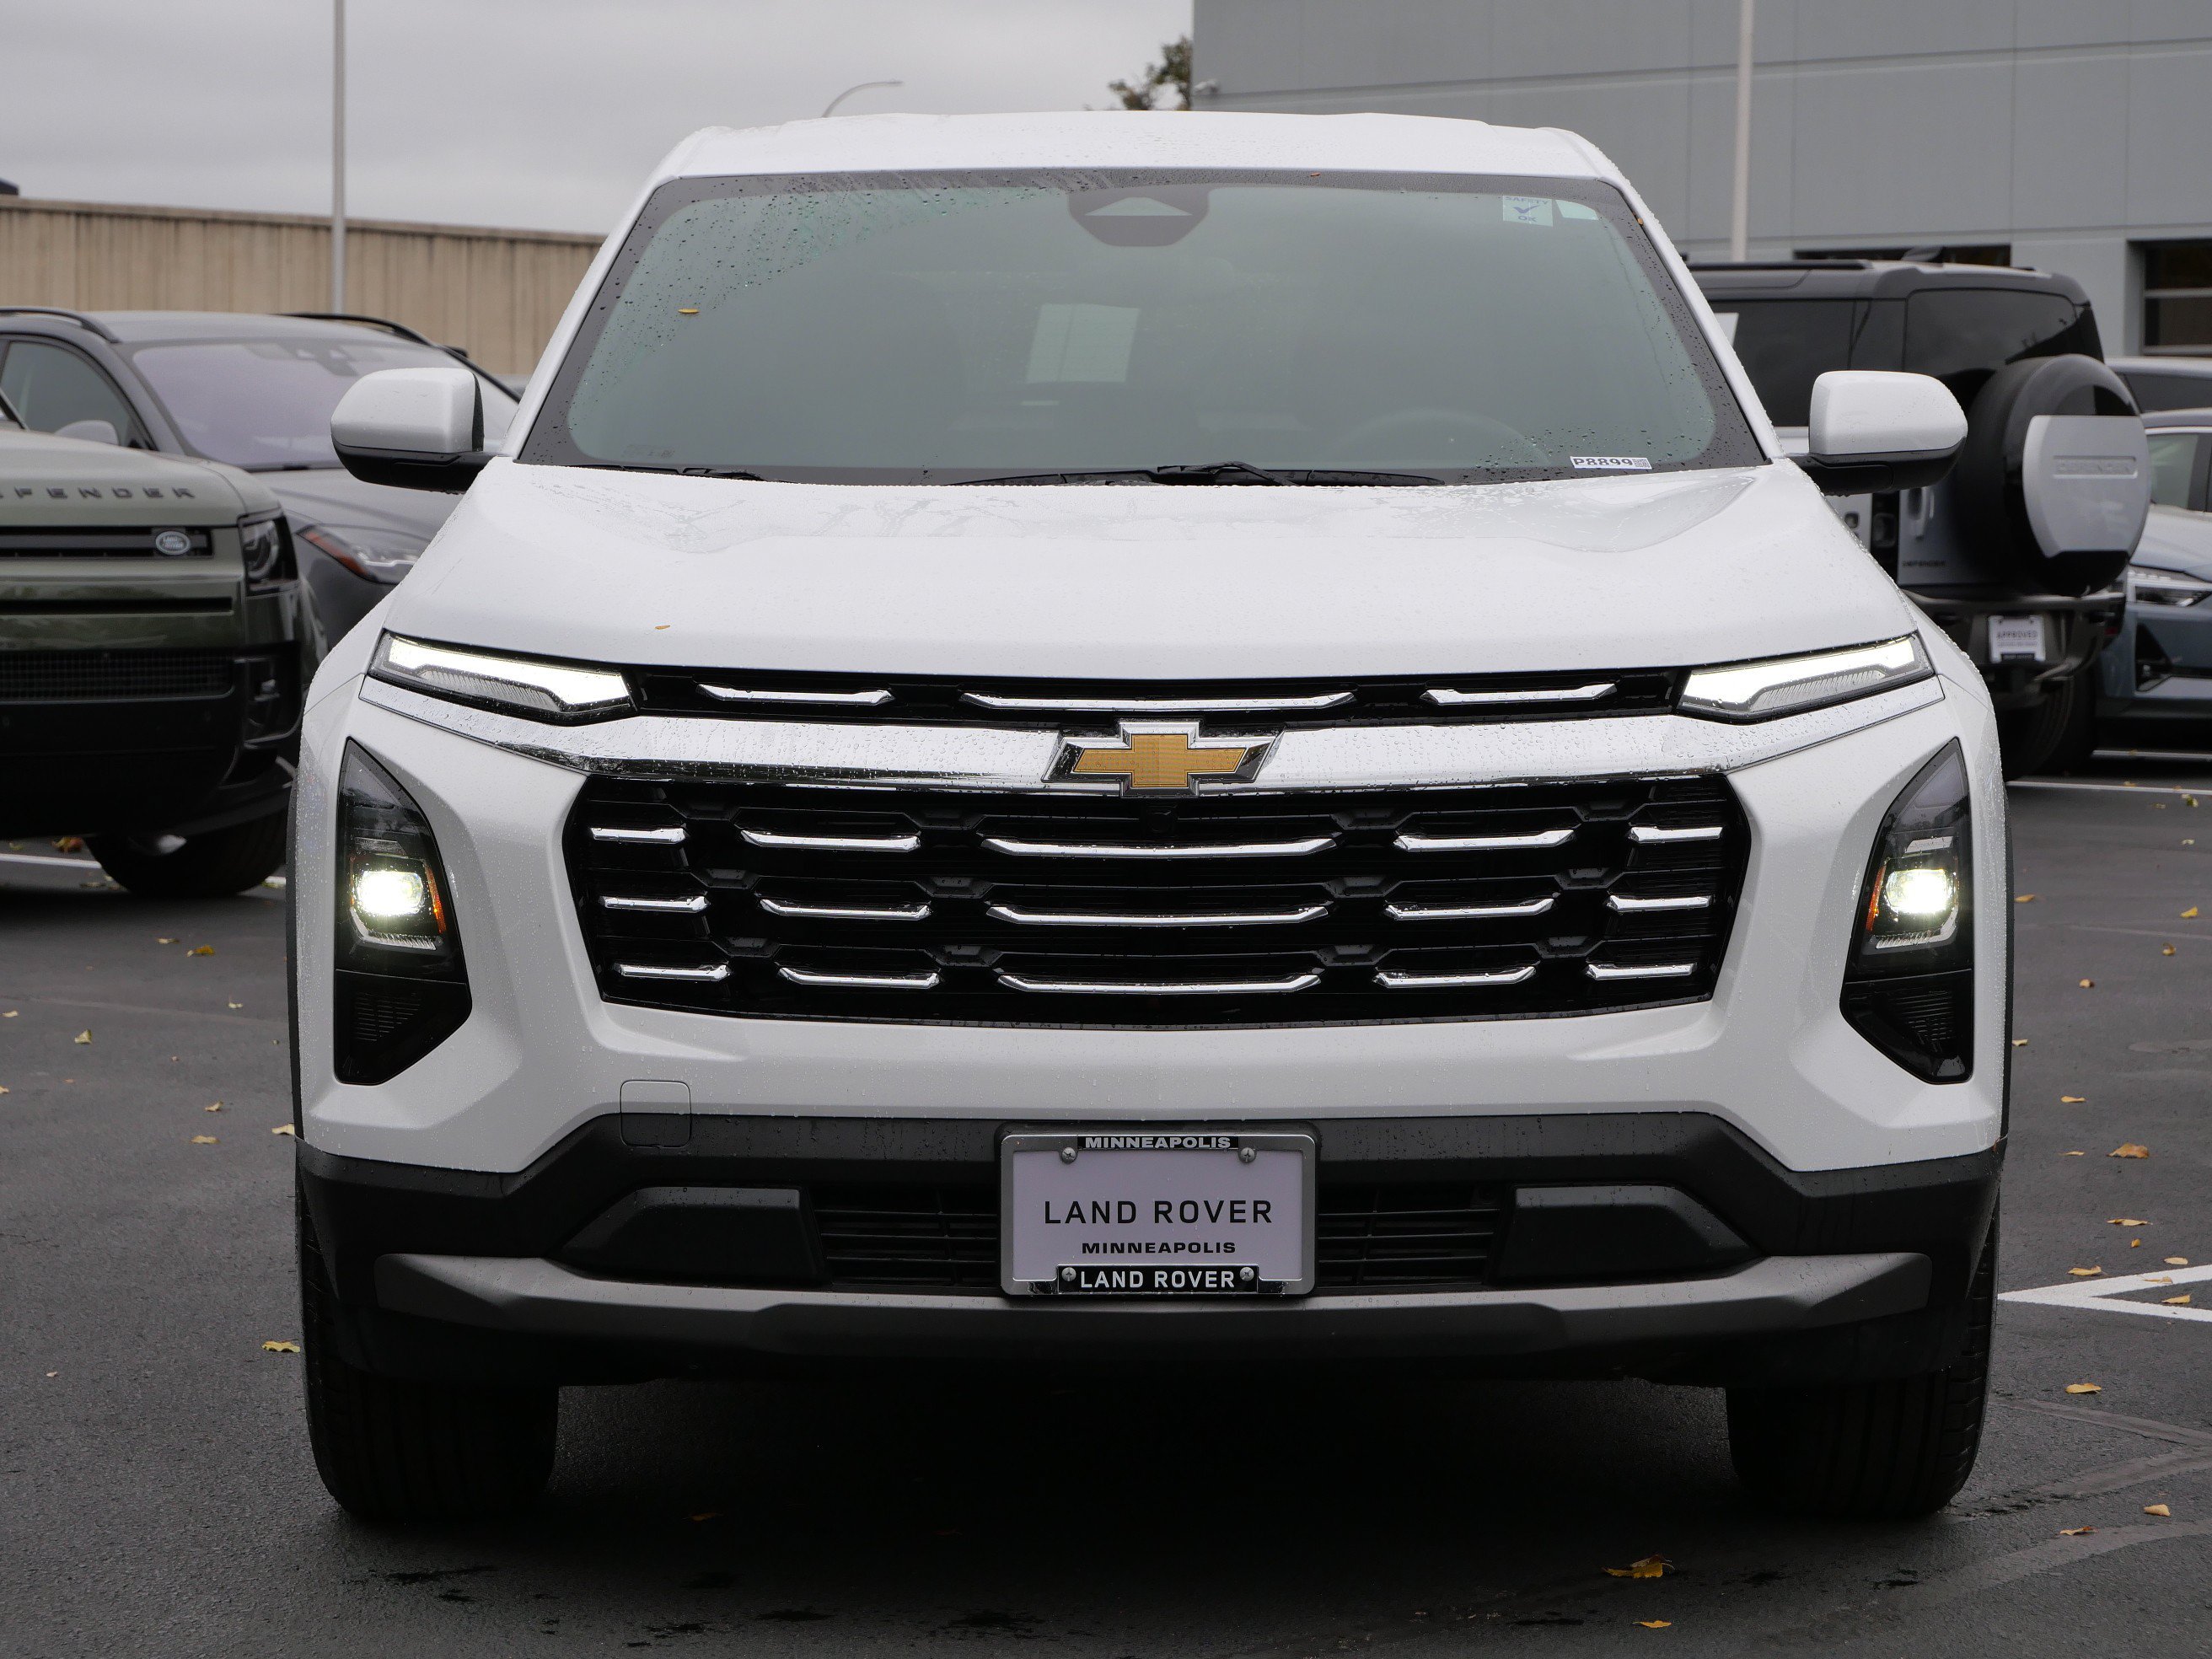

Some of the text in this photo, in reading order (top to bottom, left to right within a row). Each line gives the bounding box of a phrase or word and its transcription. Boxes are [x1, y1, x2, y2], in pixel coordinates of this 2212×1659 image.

[1506, 196, 1549, 205] SAFETY
[0, 487, 196, 498] FENDER
[1085, 1136, 1231, 1148] MINNEAPOLIS
[1044, 1200, 1273, 1224] LAND ROVER
[1082, 1242, 1236, 1254] MINNEAPOLIS
[1081, 1270, 1235, 1288] LAND ROVER
